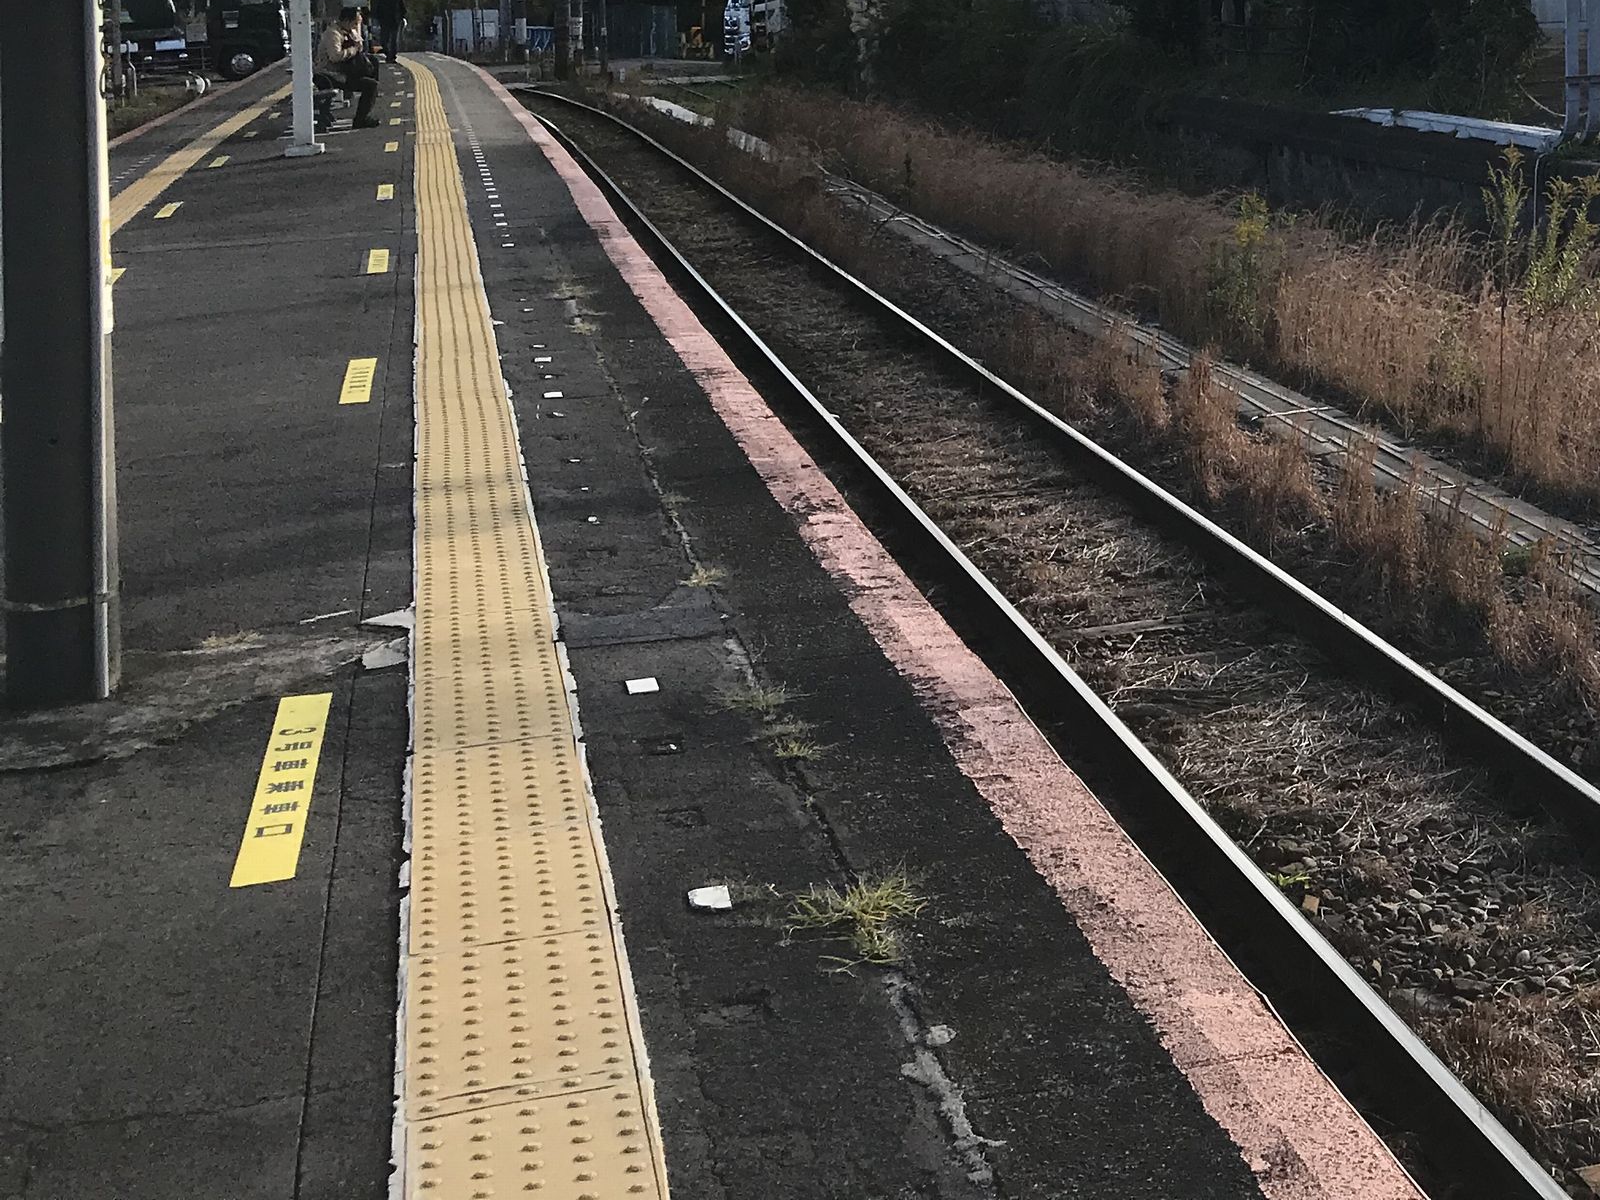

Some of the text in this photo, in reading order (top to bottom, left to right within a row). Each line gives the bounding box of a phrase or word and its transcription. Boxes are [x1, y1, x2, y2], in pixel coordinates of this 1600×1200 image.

[253, 727, 317, 838] 3号車乗車口
